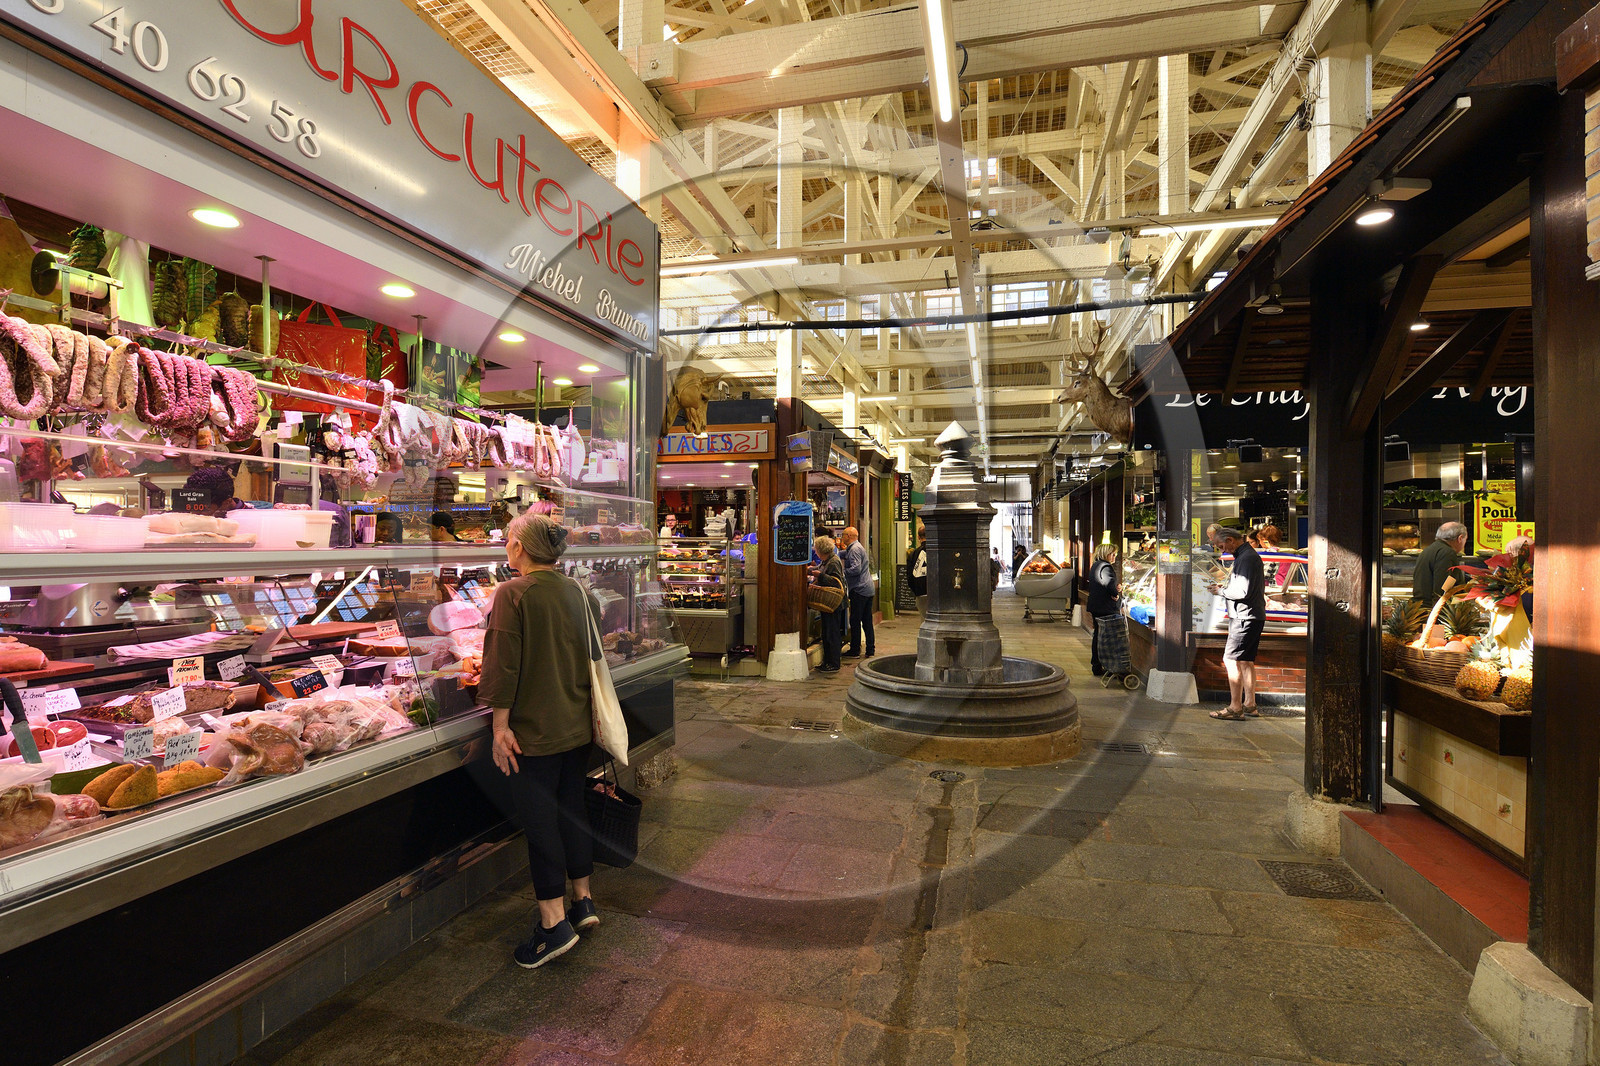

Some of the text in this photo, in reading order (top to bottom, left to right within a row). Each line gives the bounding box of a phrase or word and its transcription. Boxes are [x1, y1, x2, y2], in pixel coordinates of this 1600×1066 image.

[90, 6, 322, 158] 40 62 58
[504, 243, 649, 341] Michel Brunon
[901, 501, 909, 520] QUAIS
[1482, 506, 1517, 518] Poul
